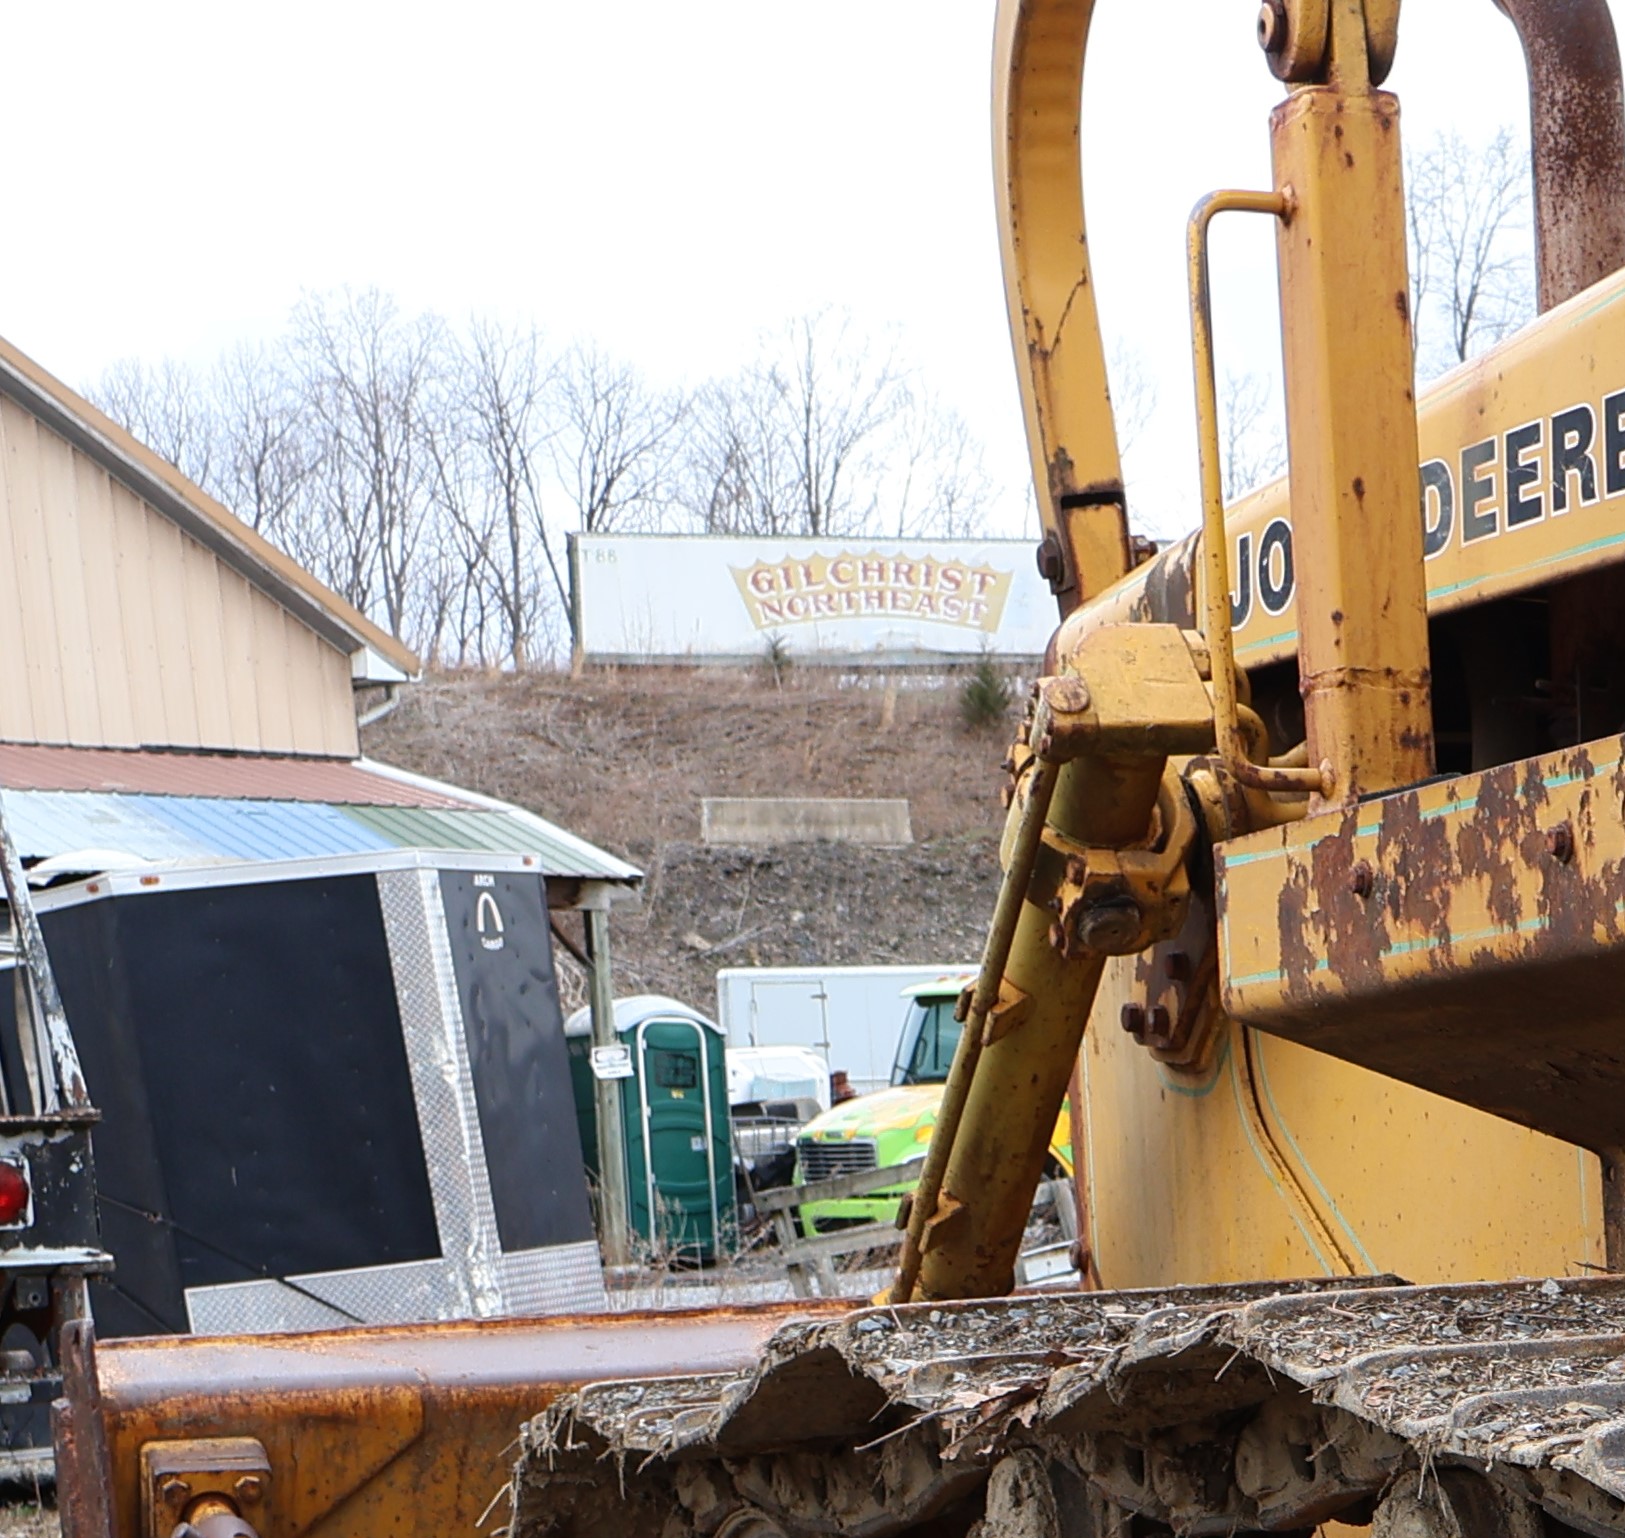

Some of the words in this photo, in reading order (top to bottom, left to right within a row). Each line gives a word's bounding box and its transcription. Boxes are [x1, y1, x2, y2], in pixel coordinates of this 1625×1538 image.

[747, 559, 996, 599] GILCHRIST
[1230, 517, 1296, 632] JO
[755, 589, 988, 625] NORTHEAST
